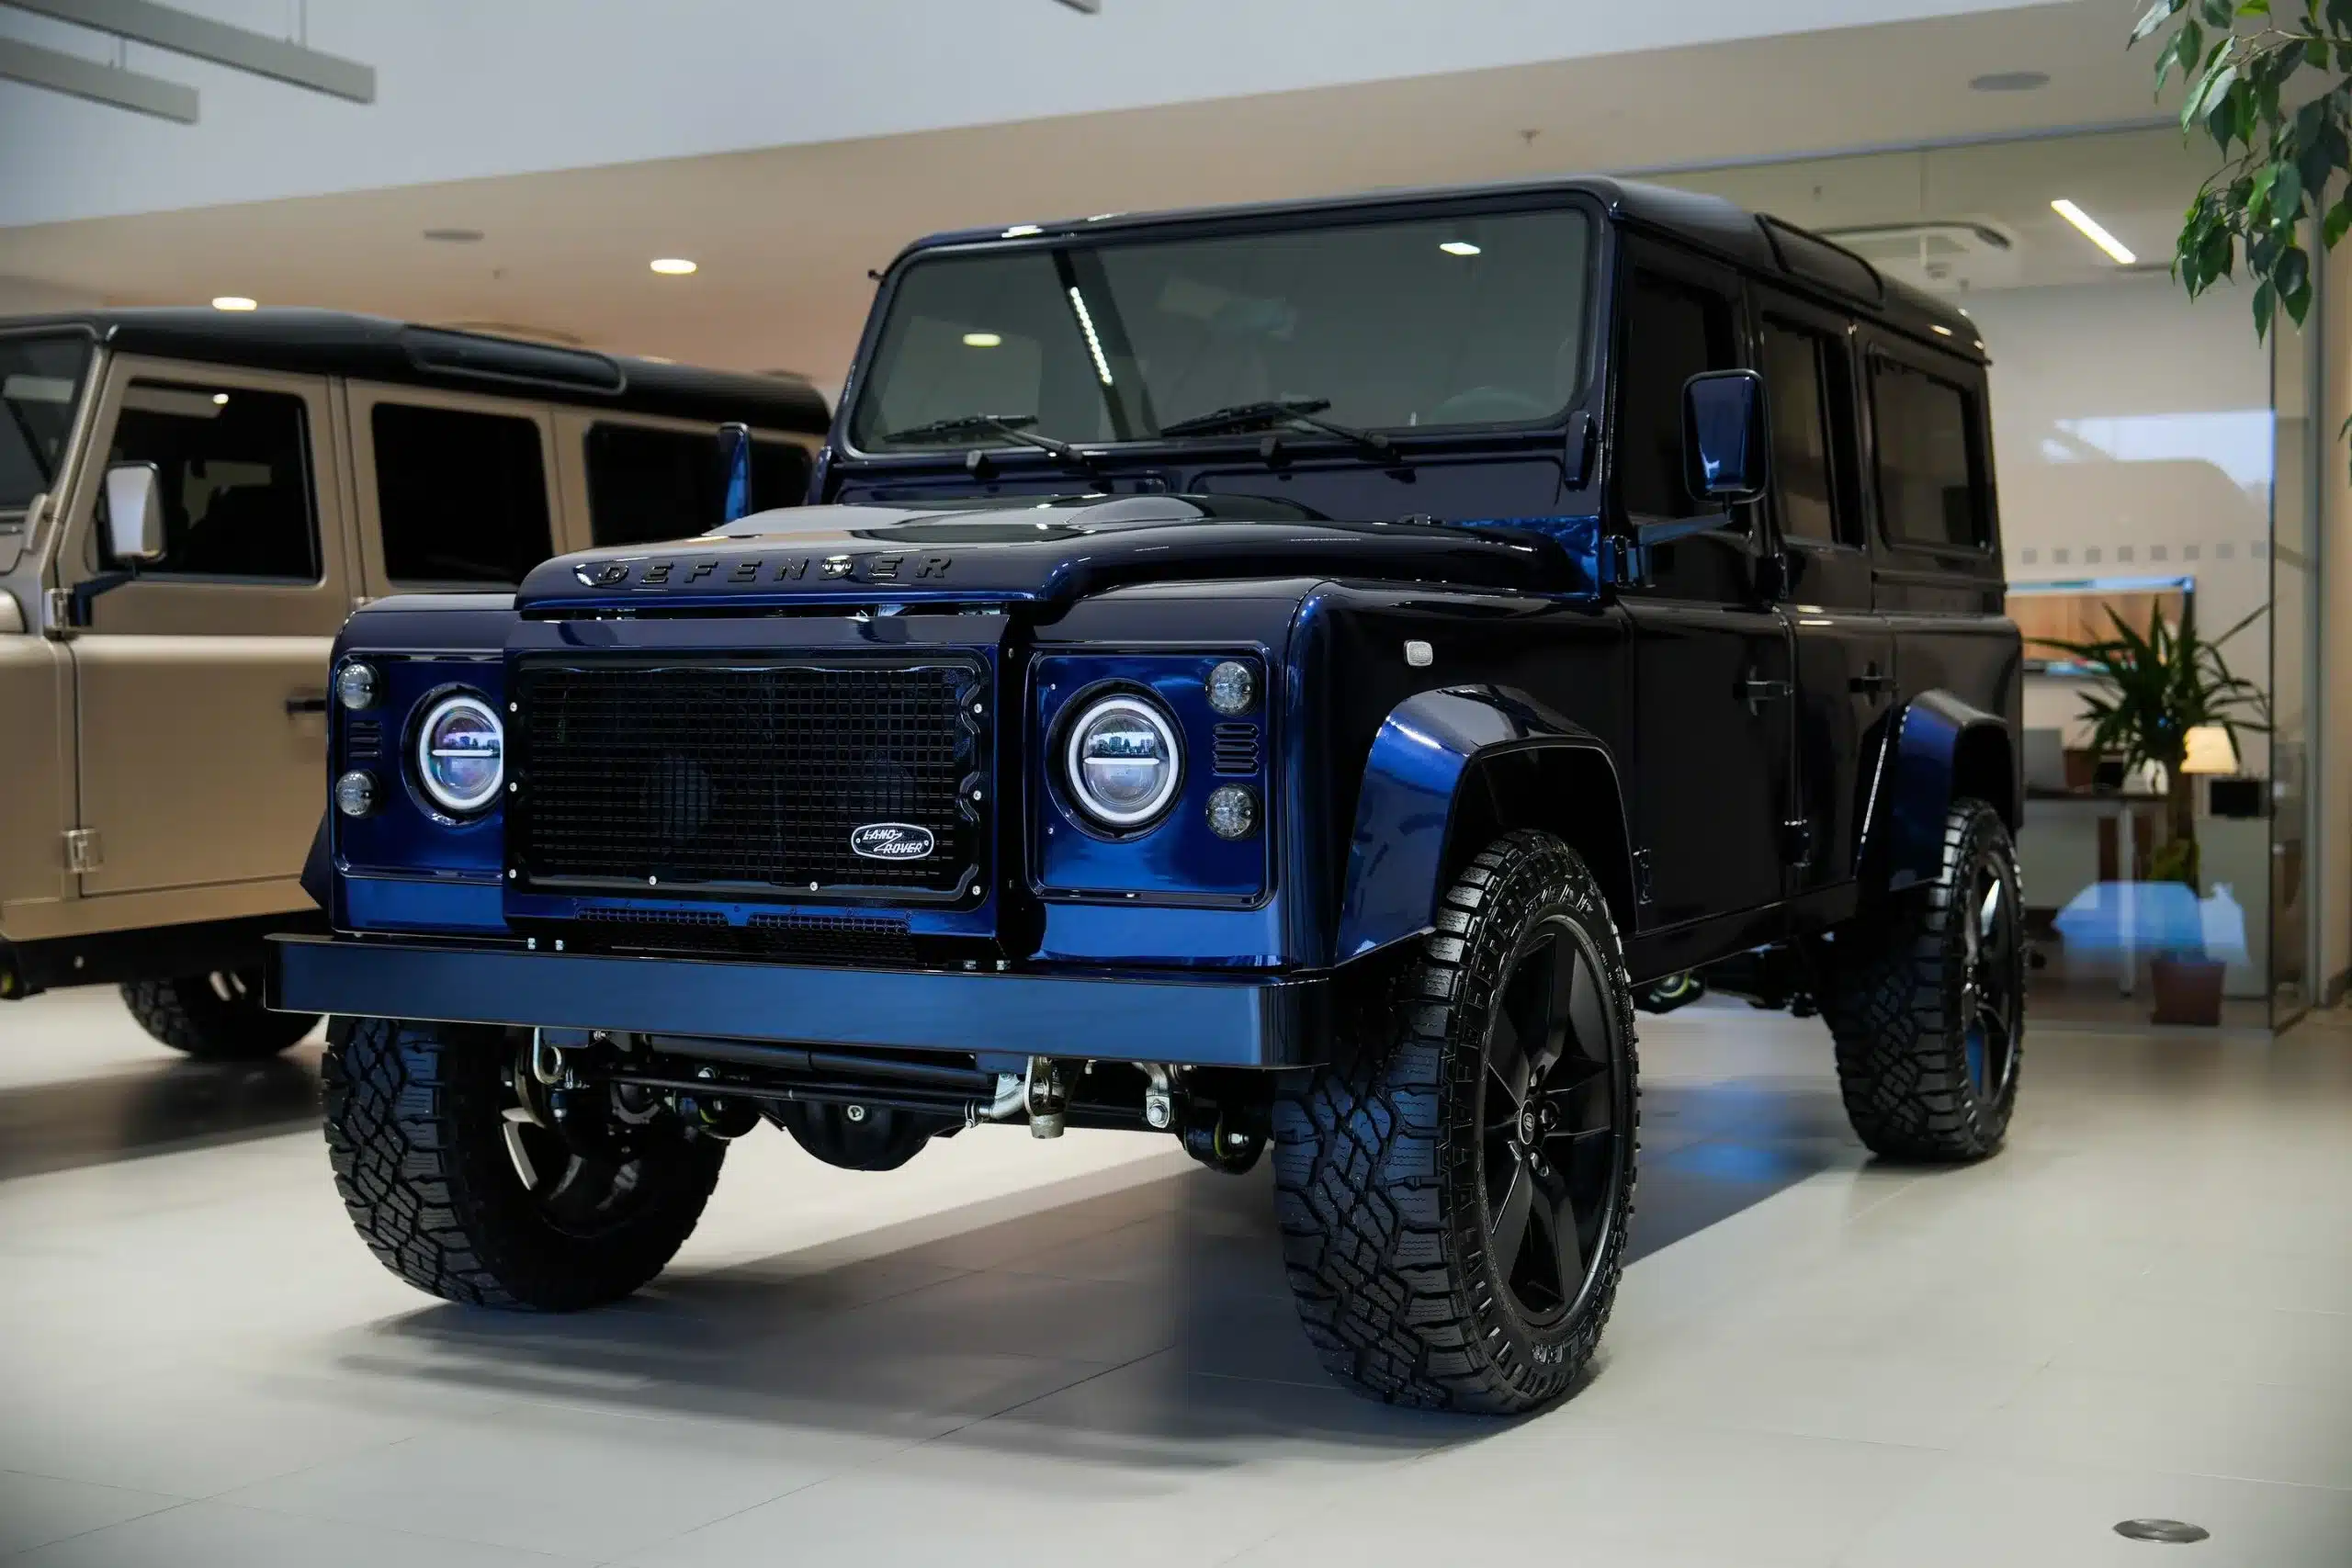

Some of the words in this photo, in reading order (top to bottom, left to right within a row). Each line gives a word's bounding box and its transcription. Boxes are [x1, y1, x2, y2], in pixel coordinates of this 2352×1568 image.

[595, 556, 954, 587] DEFENDER
[863, 829, 896, 840] LAND
[883, 842, 923, 854] ROVER
